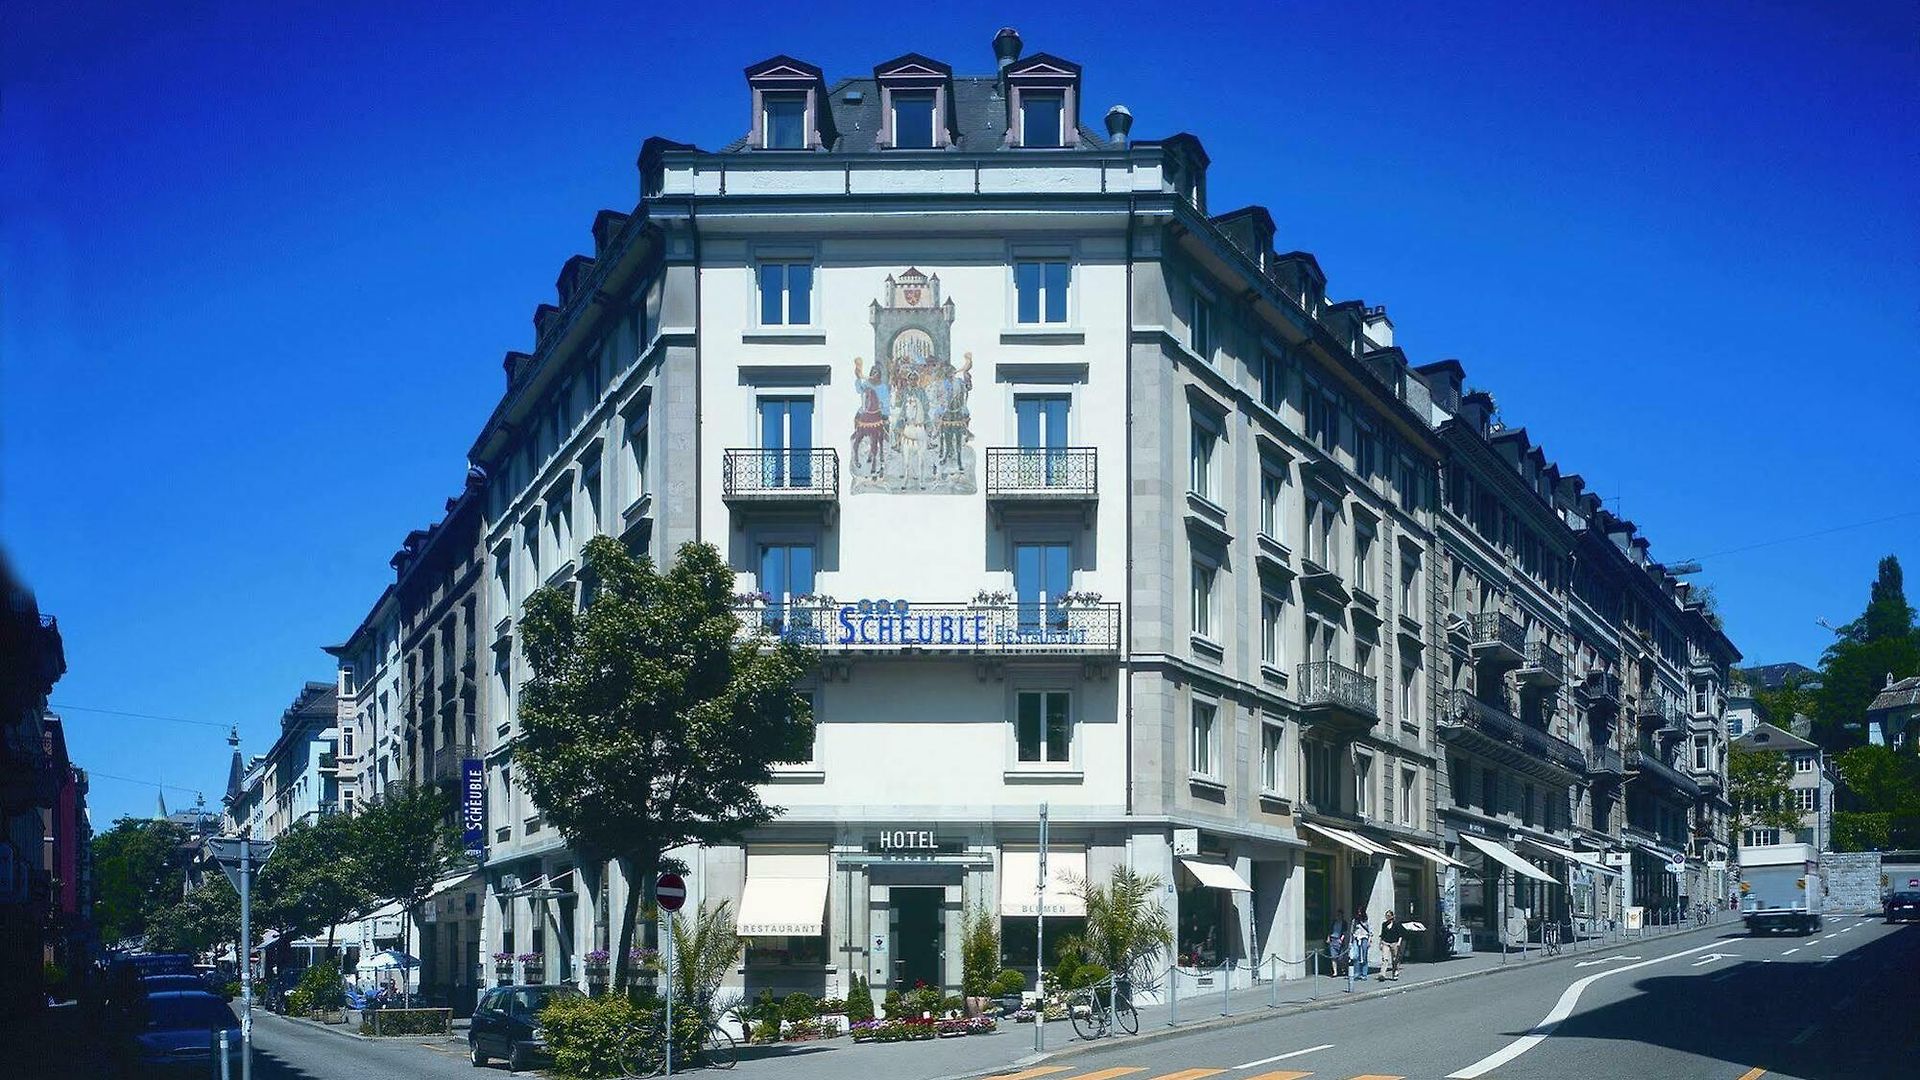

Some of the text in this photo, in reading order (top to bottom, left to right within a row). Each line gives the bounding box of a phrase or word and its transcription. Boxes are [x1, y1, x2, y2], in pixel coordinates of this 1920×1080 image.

[838, 606, 987, 645] SCHEUBLE
[466, 770, 483, 831] SCHEUBLE
[880, 831, 939, 849] HOTEL
[743, 924, 817, 933] RESTAURANT
